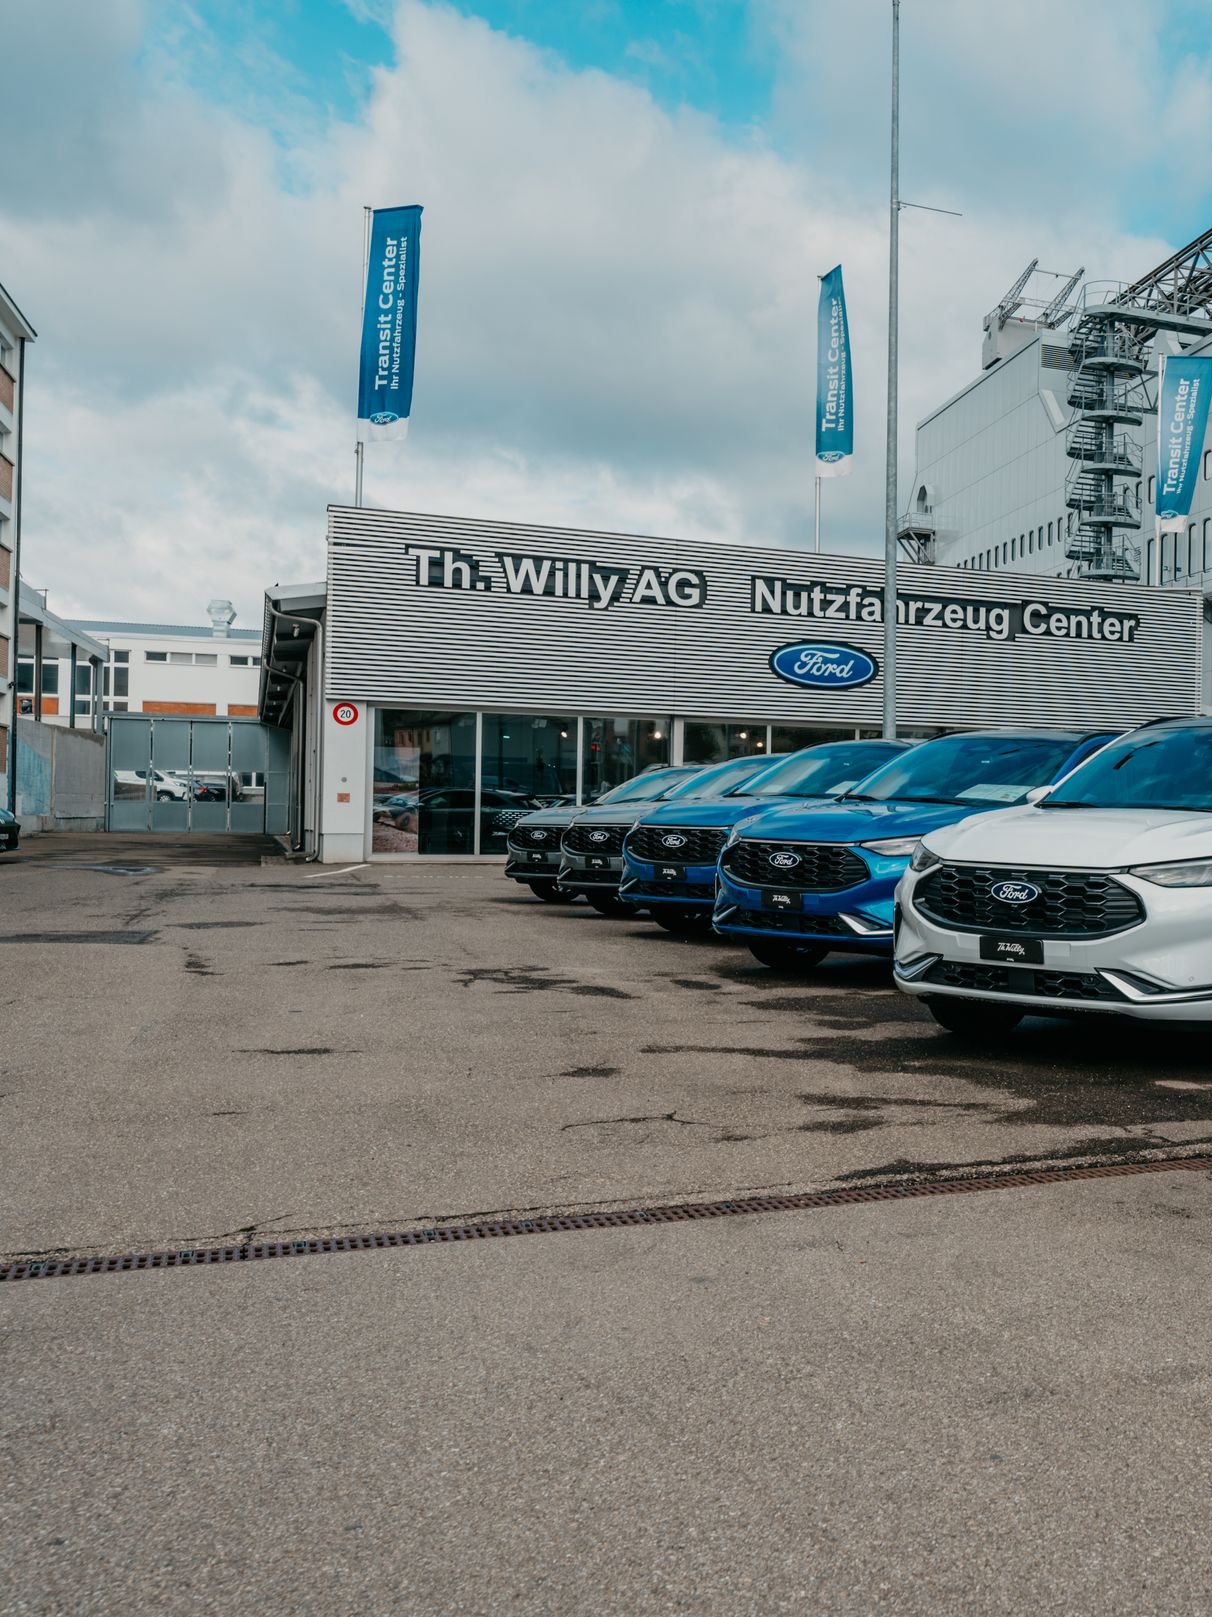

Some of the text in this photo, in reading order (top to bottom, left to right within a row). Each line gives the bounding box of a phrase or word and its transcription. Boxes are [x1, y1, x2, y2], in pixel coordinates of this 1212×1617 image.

[397, 236, 408, 291] Spezialist
[375, 237, 398, 391] Transit Center
[392, 299, 406, 373] Nutzfahrzeug
[390, 375, 399, 390] Ihr
[822, 298, 840, 432] Transit Center
[1171, 378, 1190, 434] Center
[1163, 437, 1183, 495] Transit
[407, 547, 702, 608] Th. Willy AG
[1023, 602, 1137, 641] Center
[794, 650, 854, 679] Ford
[340, 709, 352, 719] 20
[1000, 885, 1028, 900] Ford
